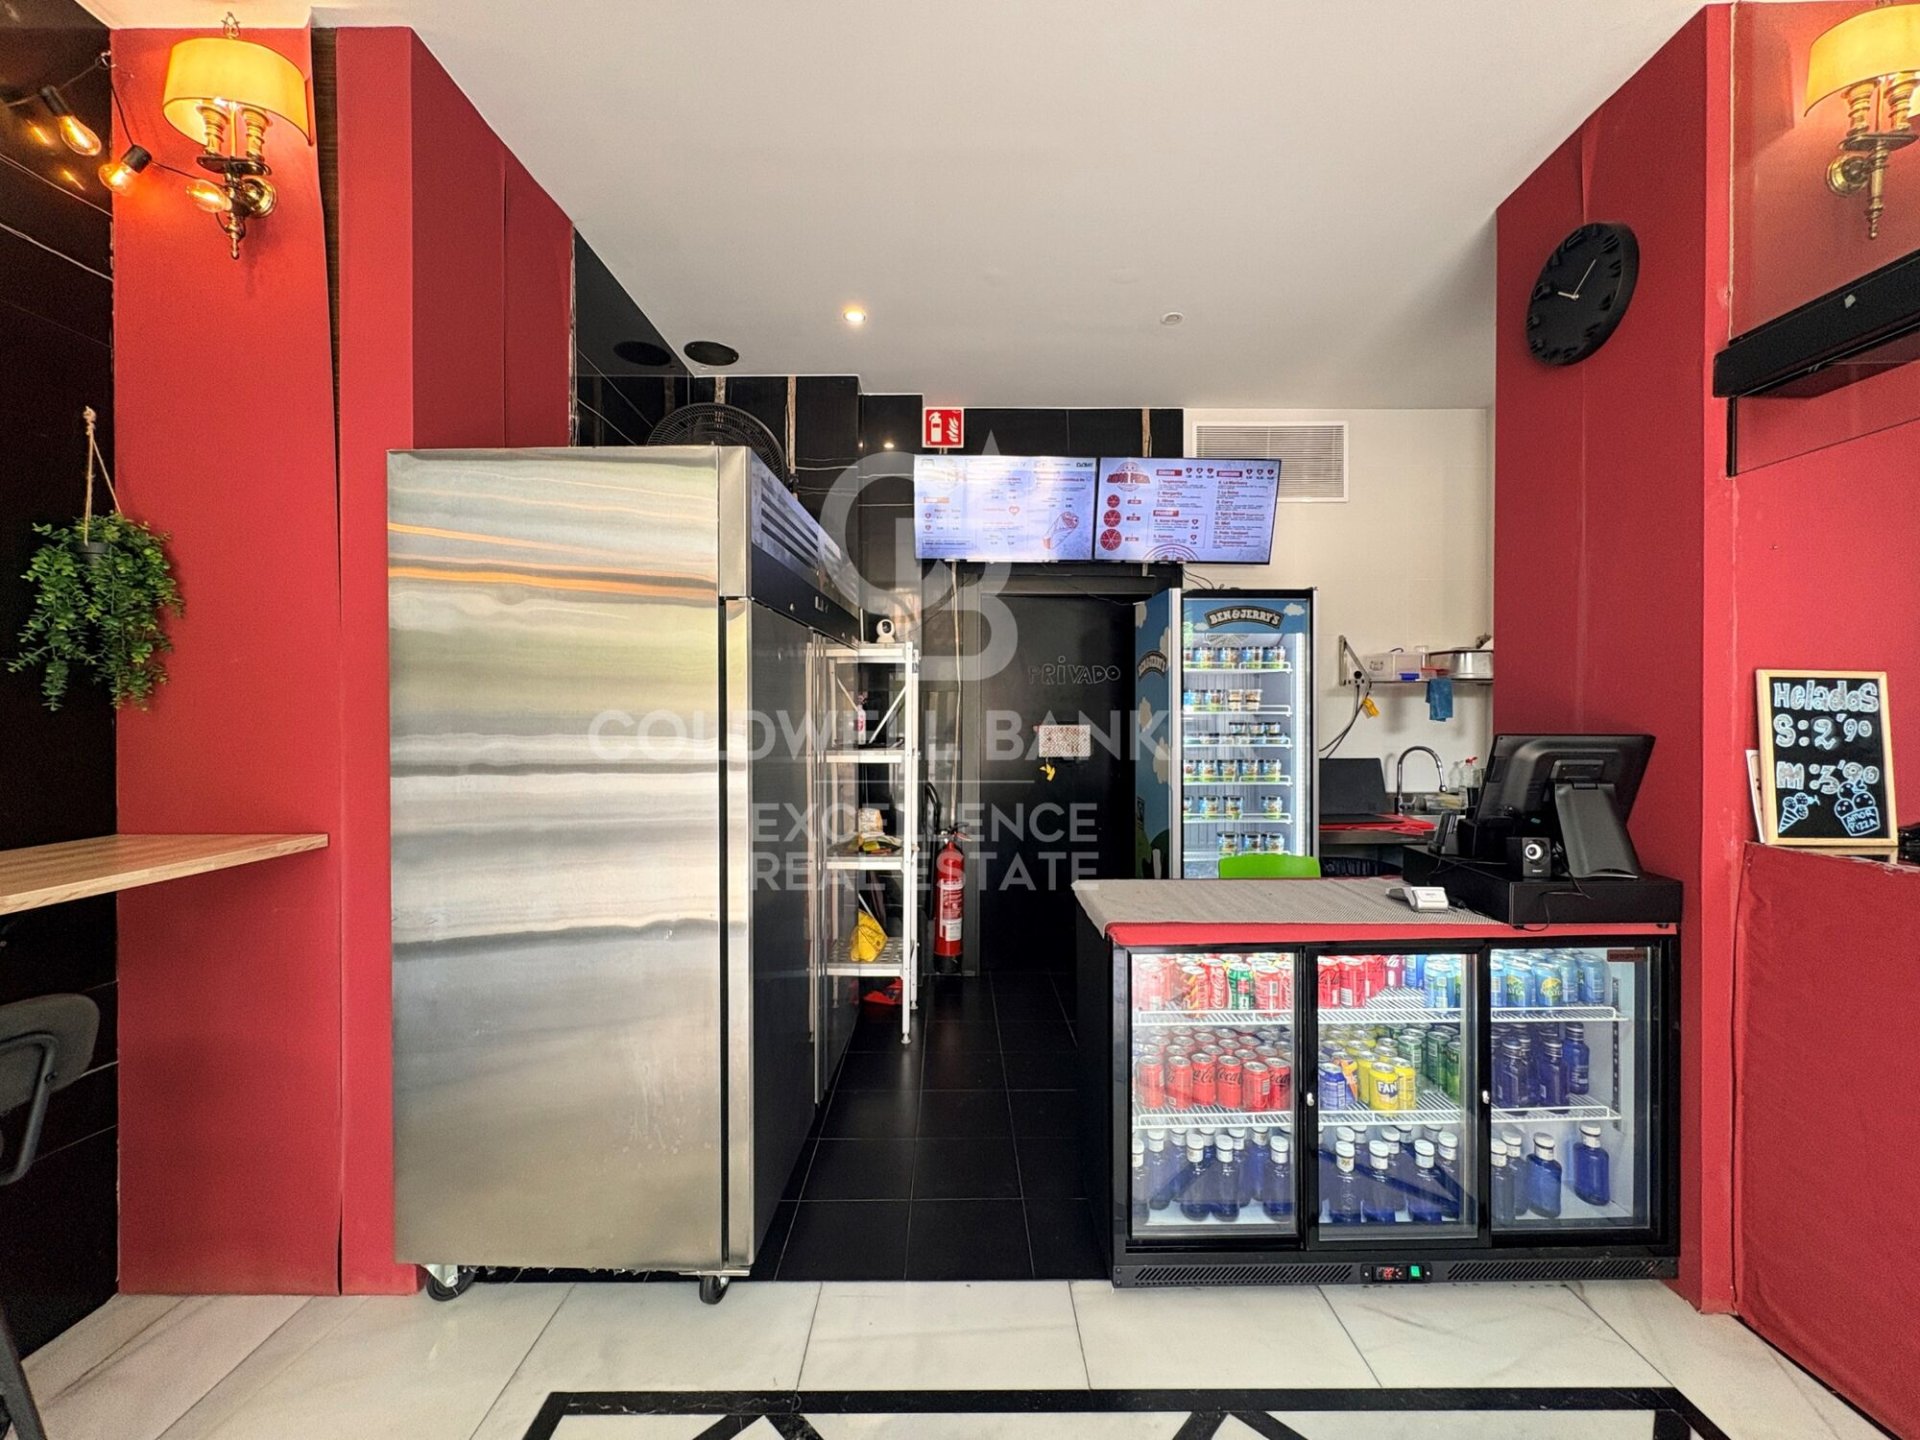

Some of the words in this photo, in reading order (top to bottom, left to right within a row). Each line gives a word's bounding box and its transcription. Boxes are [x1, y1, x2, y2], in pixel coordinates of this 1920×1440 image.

[1846, 808, 1876, 823] AMOR
[1849, 817, 1876, 832] PIZZA
[1377, 1081, 1398, 1093] FAN
